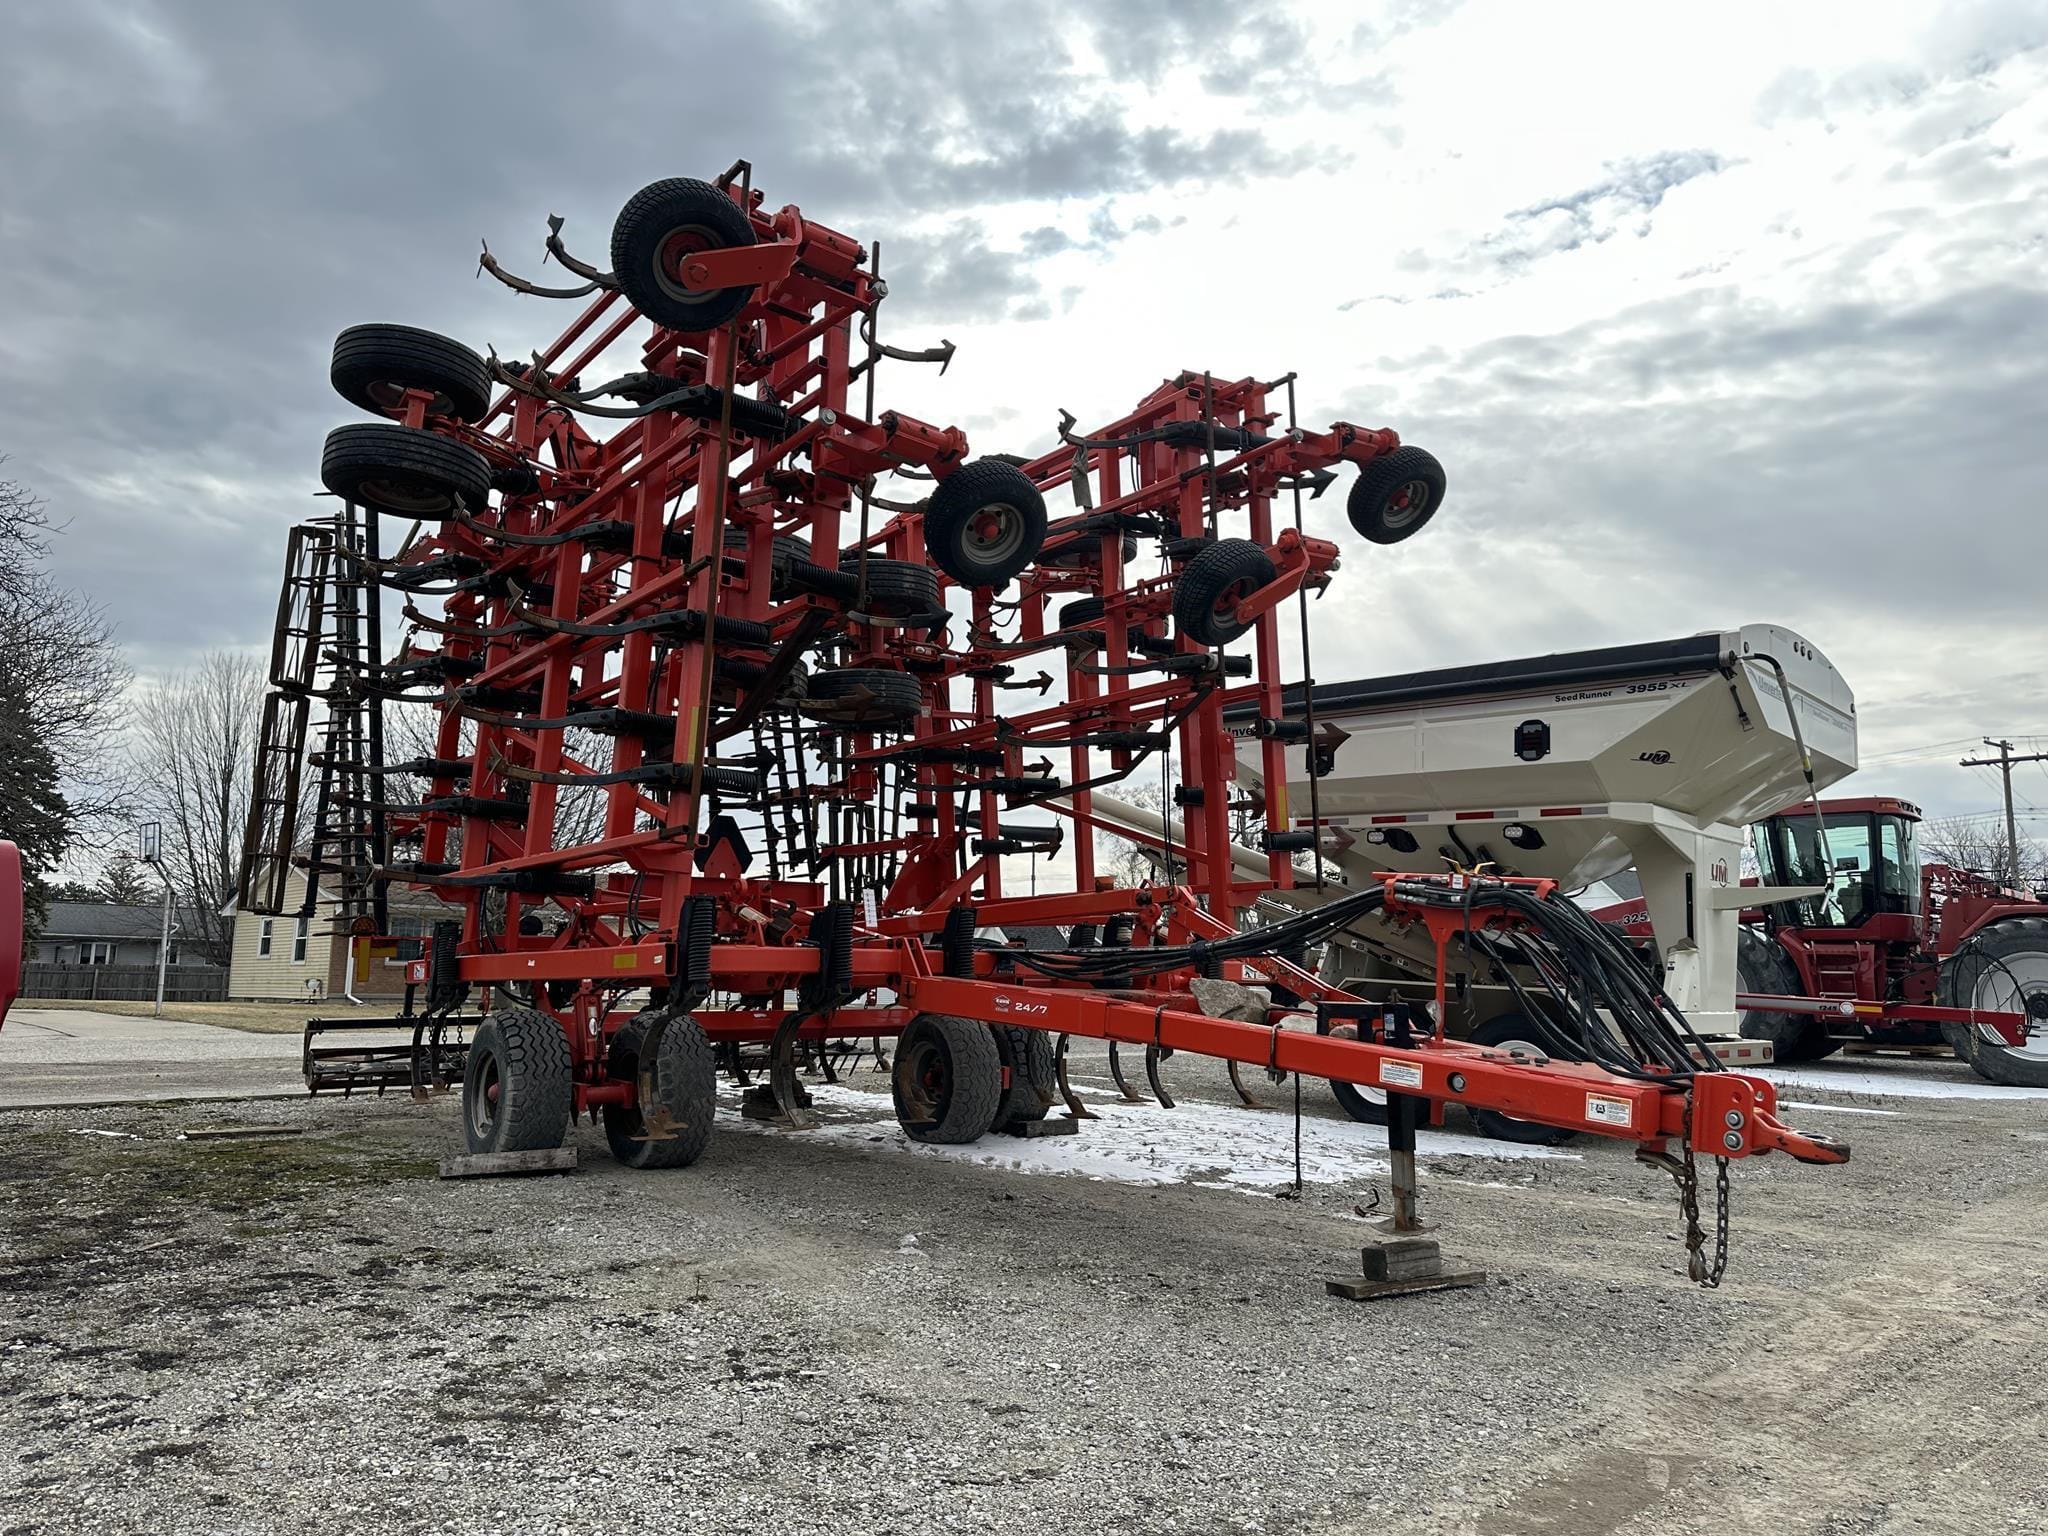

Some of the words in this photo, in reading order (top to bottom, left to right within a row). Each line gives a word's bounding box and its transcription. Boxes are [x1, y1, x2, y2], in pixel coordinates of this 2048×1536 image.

[1554, 693, 1578, 703] Seed
[1580, 690, 1613, 700] Runner
[1626, 681, 1668, 694] 3955
[1623, 911, 1648, 925] 325
[1015, 1002, 1048, 1014] 24/7
